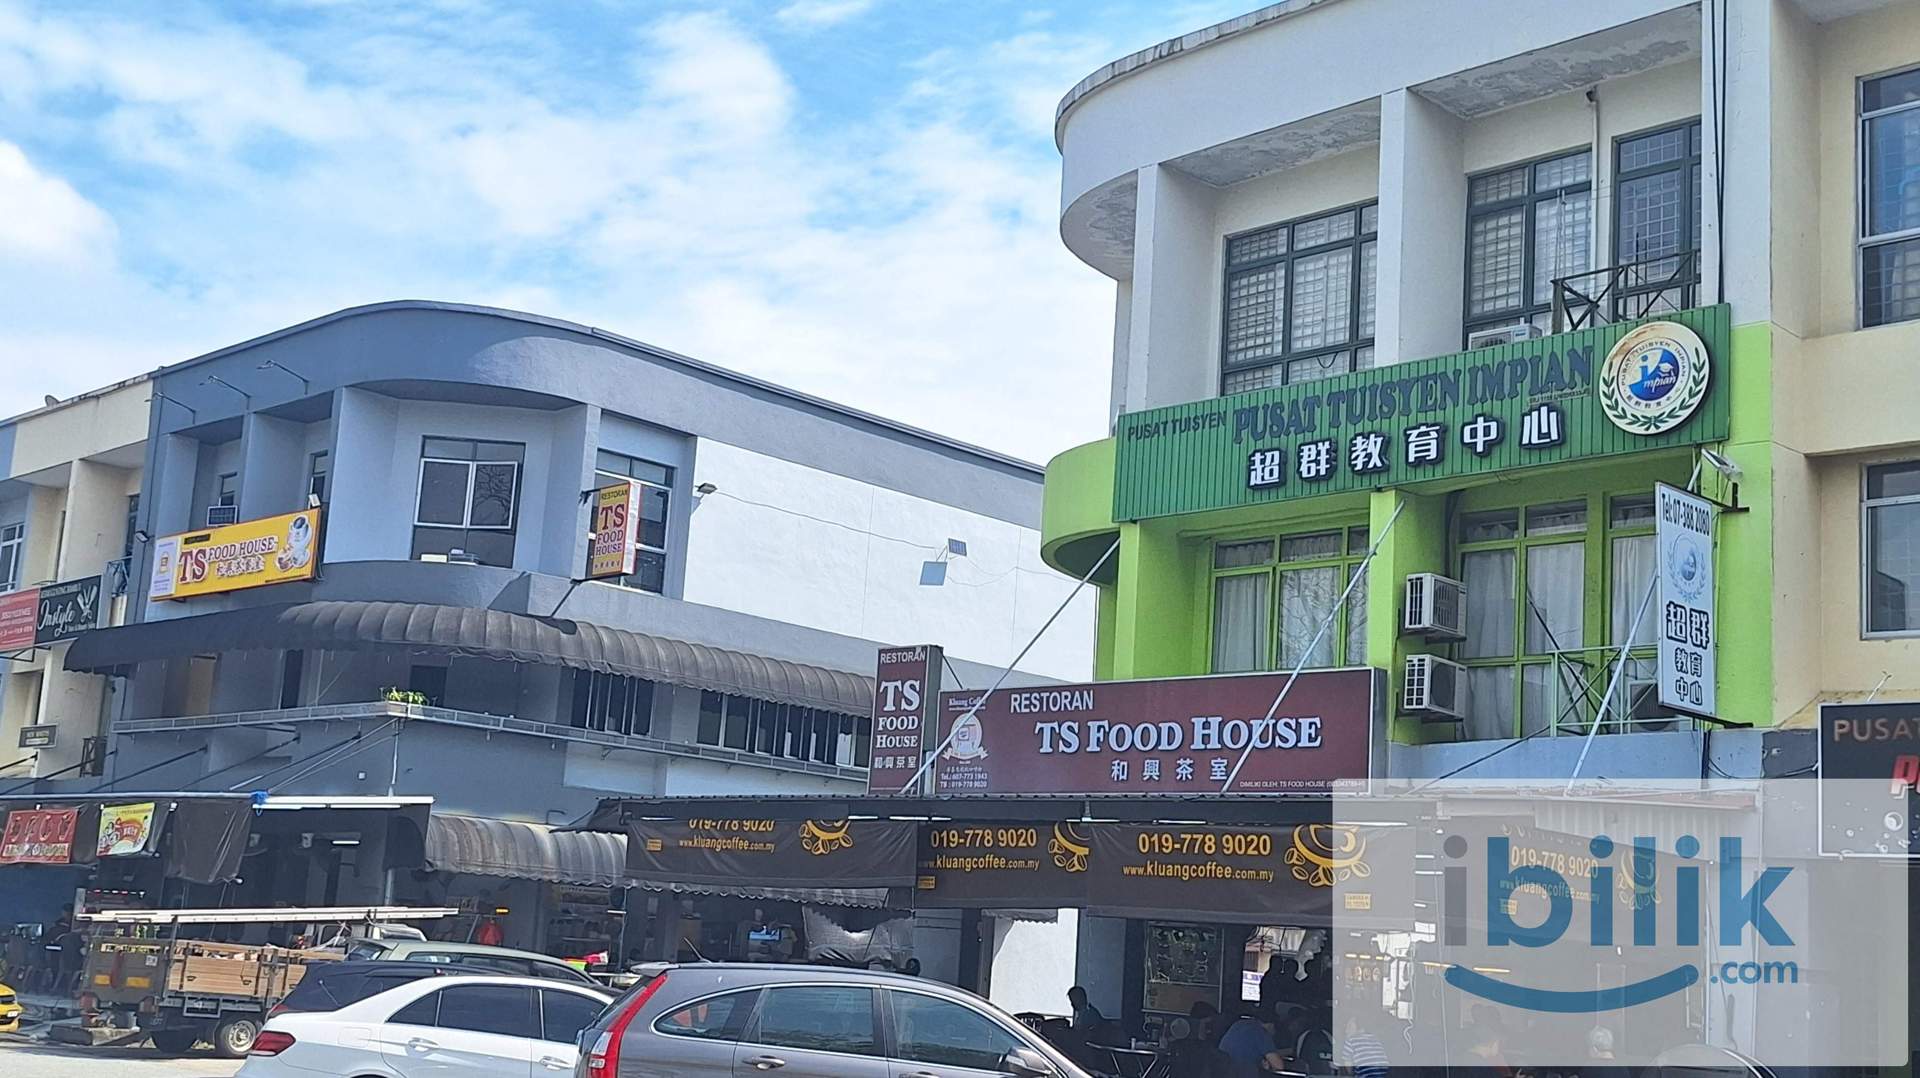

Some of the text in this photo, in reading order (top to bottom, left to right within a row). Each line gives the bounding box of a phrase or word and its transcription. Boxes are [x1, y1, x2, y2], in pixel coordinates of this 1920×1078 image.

[1233, 394, 1321, 445] PUSAT
[1326, 367, 1462, 431] TUISYEN
[1467, 345, 1594, 406] IMPIAN
[1127, 411, 1227, 442] PUSAT TUISYEN
[1249, 405, 1559, 487] 超群教育中心
[600, 503, 625, 530] TS
[595, 543, 622, 557] HOUSE
[597, 530, 624, 544] FOOD
[178, 548, 207, 582] TS
[208, 544, 237, 561] FOOD
[239, 536, 275, 557] HOUSE
[1666, 602, 1710, 649] 超群
[880, 650, 926, 665] RESTORAN
[1675, 647, 1703, 678] 教育
[879, 679, 920, 712] TS
[1010, 689, 1094, 714] RESTORAN
[1675, 677, 1703, 706] 中心
[877, 715, 919, 731] FOOD
[1035, 716, 1322, 754] TS FOOD HOUSE
[875, 734, 918, 748] HOUSE
[1111, 757, 1229, 783] 和興茶室
[930, 828, 1037, 848] 019-778 9020
[1138, 832, 1271, 856] 019-778 9020
[1122, 860, 1274, 883] www.kluangcoffee.com.my
[1511, 845, 1599, 879] 019-778 9020
